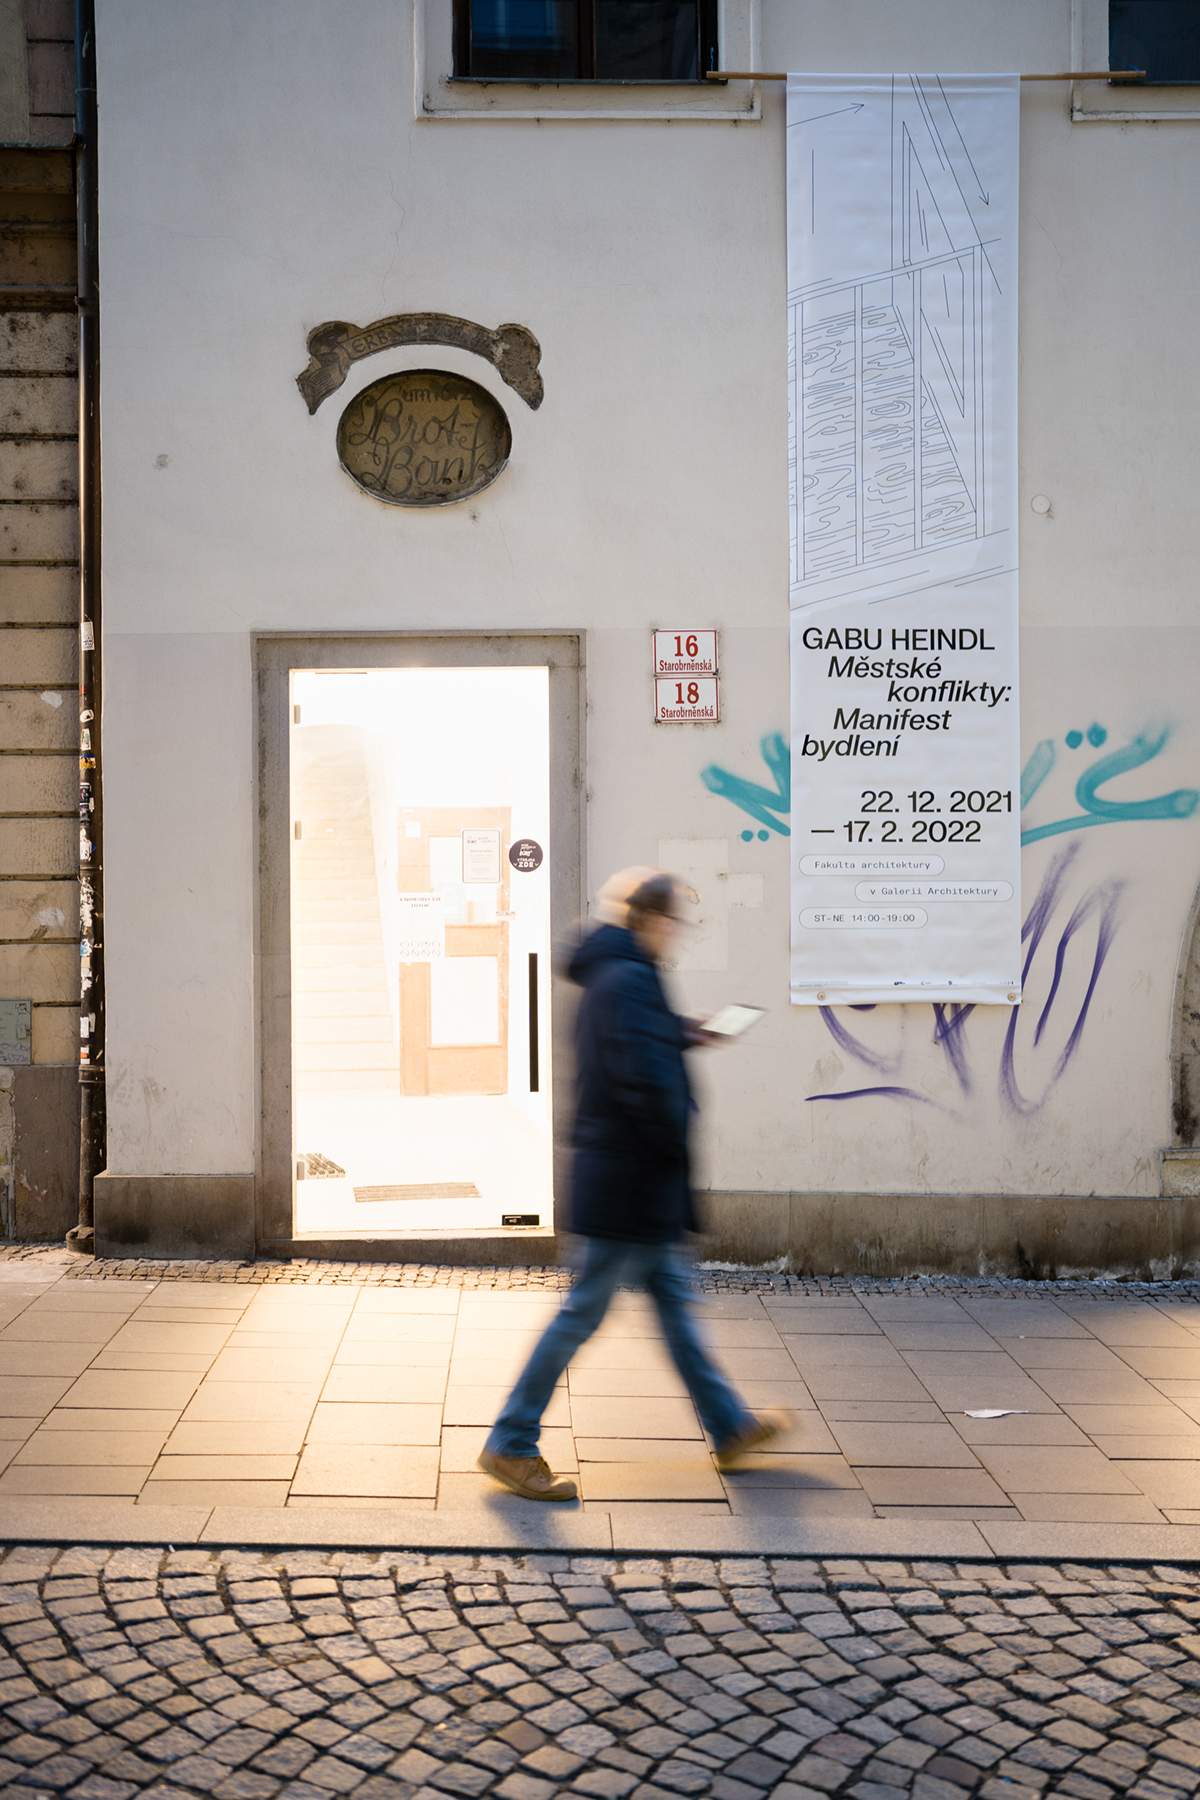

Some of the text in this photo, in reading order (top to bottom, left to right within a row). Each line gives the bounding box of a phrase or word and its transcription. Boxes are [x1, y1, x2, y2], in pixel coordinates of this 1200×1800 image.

[674, 634, 699, 657] 16
[803, 627, 995, 650] GABU HEINDL
[659, 659, 713, 671] Starobrněnská
[828, 656, 941, 678] Městské
[675, 682, 700, 704] 18
[887, 680, 1011, 708] konflikty:
[660, 705, 714, 718] Starobrněnská
[833, 708, 952, 730] Manifest
[801, 734, 901, 761] bydlení
[861, 791, 1011, 812] 22. 12. 2021
[843, 821, 872, 842] 17.
[881, 821, 903, 842] 2.
[912, 820, 981, 842] 2022
[814, 860, 931, 870] Fakulta architektury
[870, 887, 998, 897] v Galerii Architektury
[813, 914, 916, 923] ST-NE 14:00-19:00
